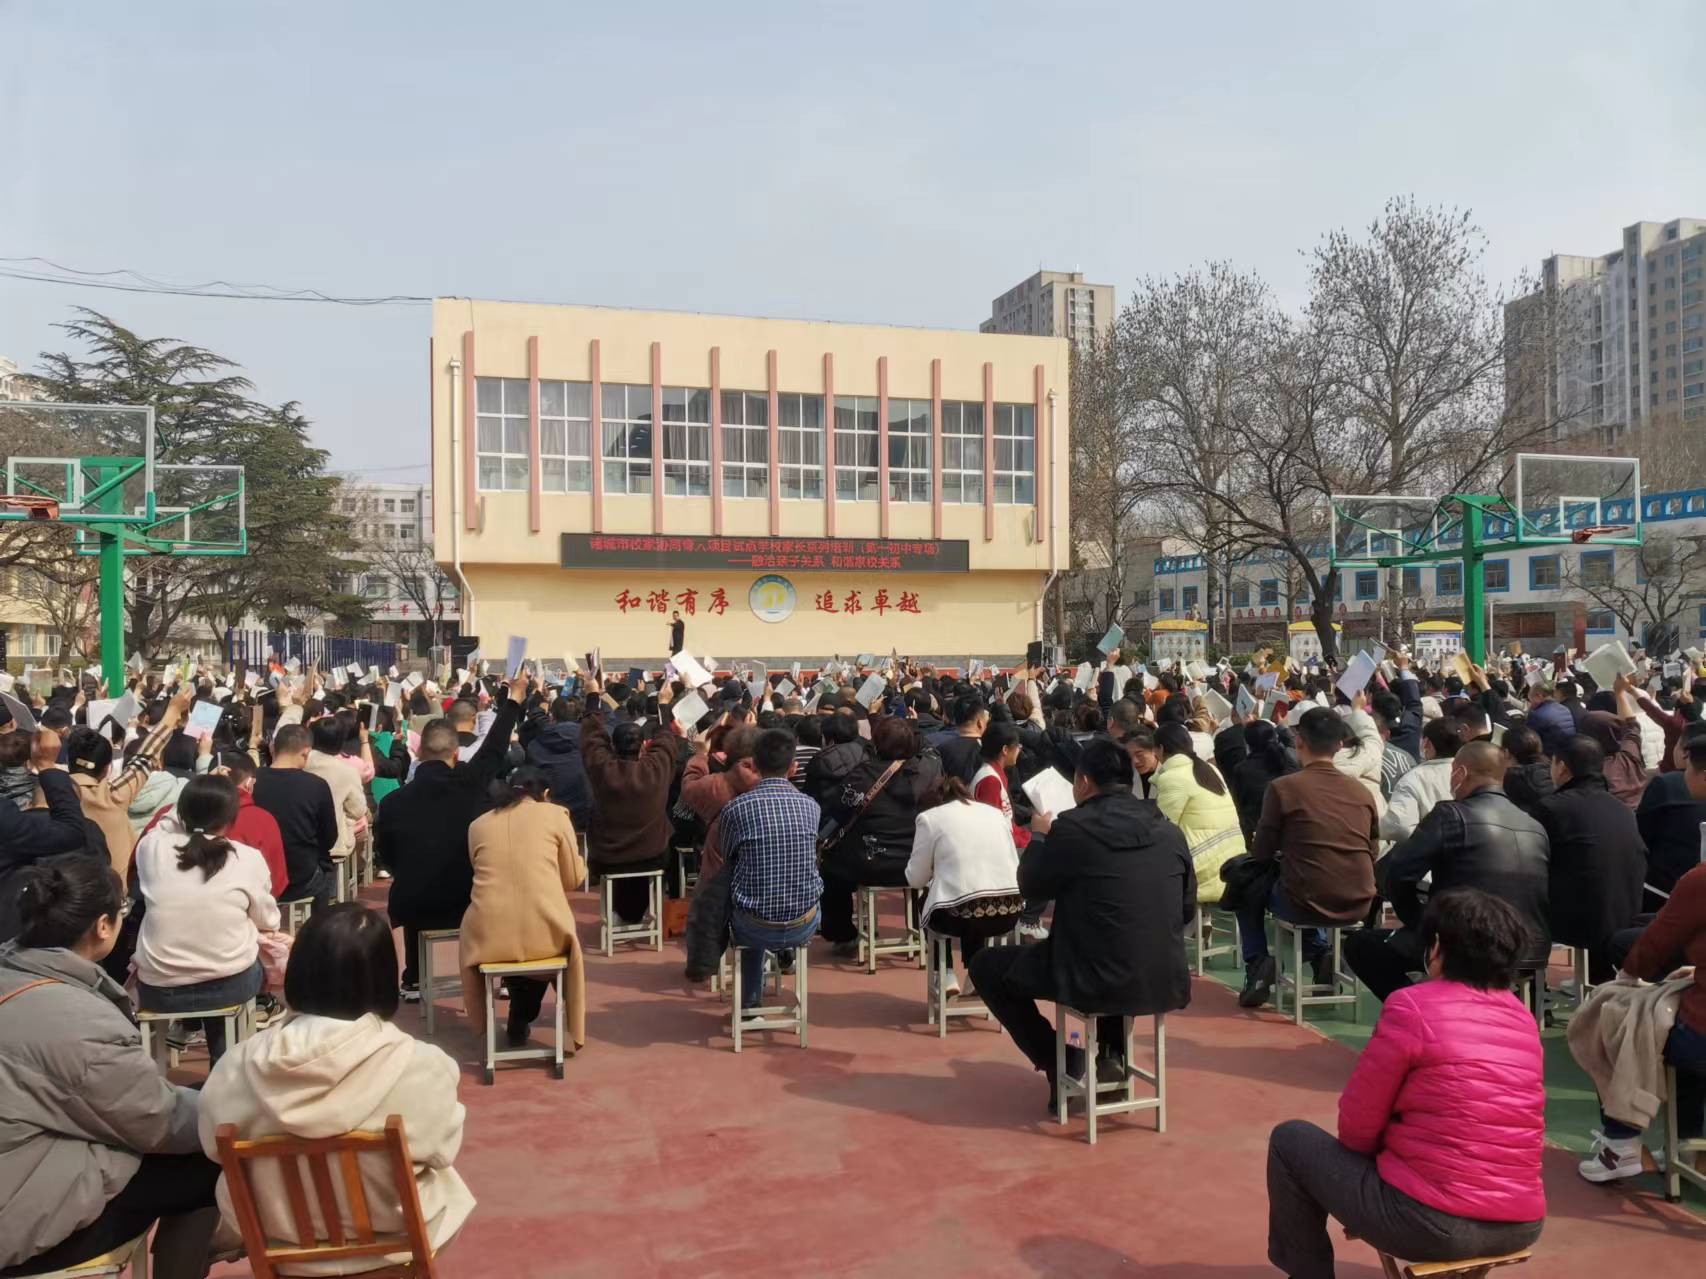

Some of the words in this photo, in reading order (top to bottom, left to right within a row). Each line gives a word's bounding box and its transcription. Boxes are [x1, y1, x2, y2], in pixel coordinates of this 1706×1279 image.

[614, 587, 730, 616] 和谐有序
[815, 589, 922, 616] 追求卓越
